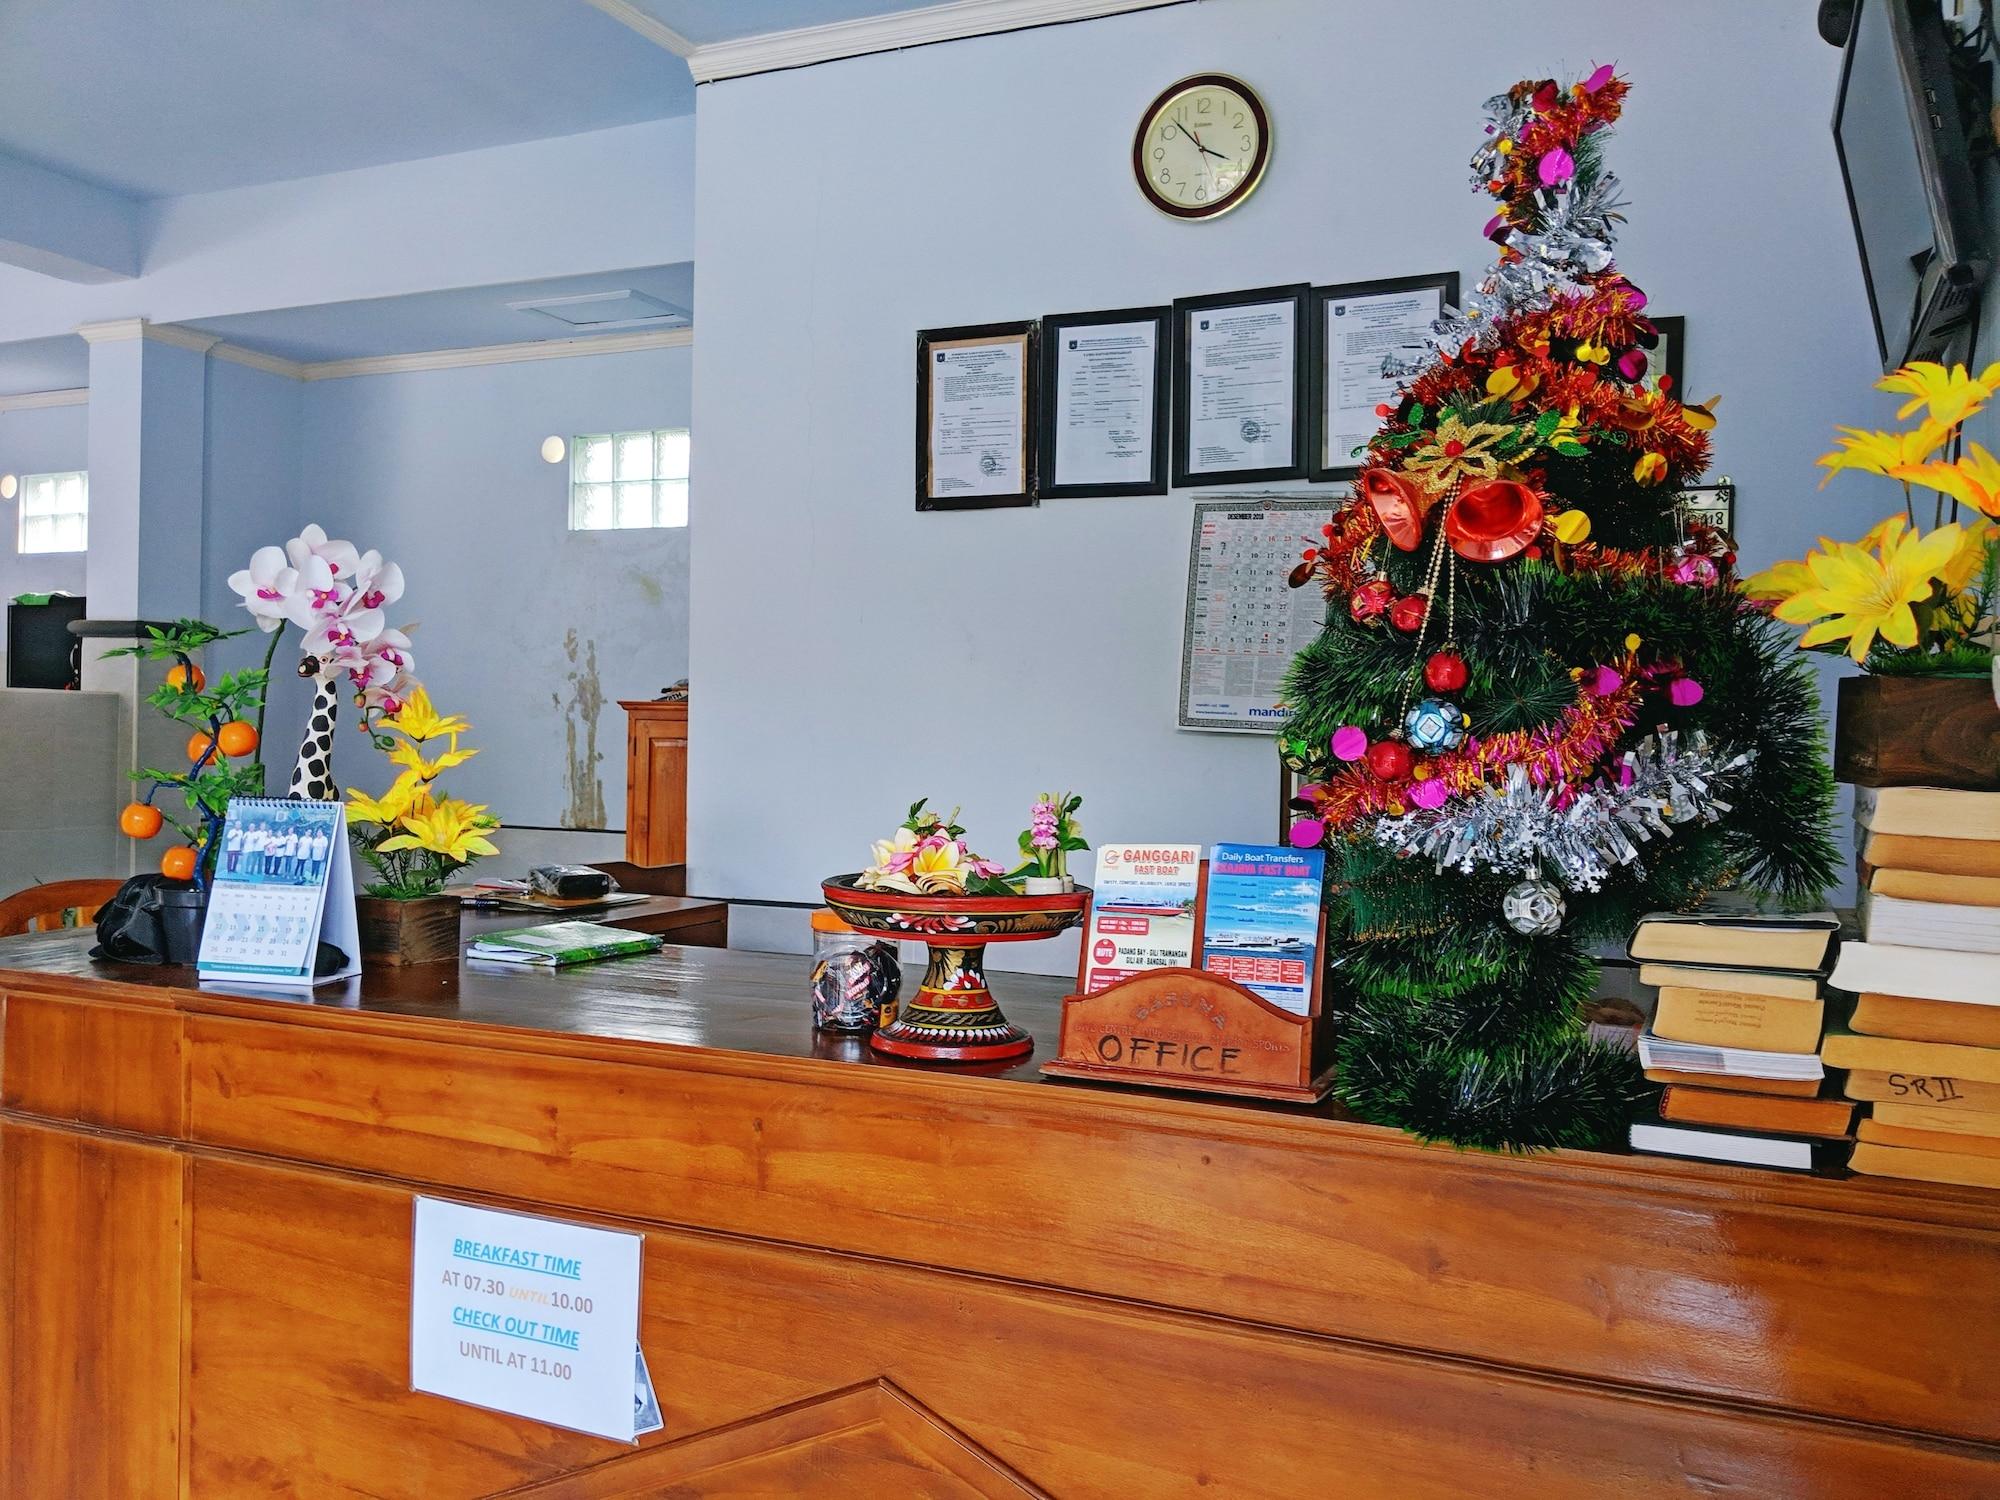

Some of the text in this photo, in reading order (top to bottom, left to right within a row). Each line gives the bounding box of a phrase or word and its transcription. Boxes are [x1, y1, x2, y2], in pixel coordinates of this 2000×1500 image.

[1177, 106, 1188, 122] 11
[1197, 97, 1211, 114] 12
[1223, 100, 1226, 116] 1
[1232, 112, 1244, 129] 2
[1160, 125, 1177, 142] 10
[1240, 135, 1251, 152] 3
[1153, 147, 1165, 163] 9
[1233, 158, 1243, 175] 4
[1159, 168, 1171, 184] 8
[1216, 177, 1229, 192] 5
[1176, 182, 1186, 197] 7
[1195, 184, 1207, 201] 6
[1123, 849, 1195, 864] GANGGARI
[1222, 852, 1304, 863] Daily Boat Transfers
[1134, 865, 1179, 875] FAST BOAT
[1137, 948, 1146, 956] BAY
[1098, 1034, 1241, 1075] OFFICE
[453, 1237, 583, 1277] BREAKFAST TIME
[441, 1269, 593, 1314] AT 07.30 UNTIL 10.00
[453, 1306, 580, 1348] CHECK OUT TIME
[459, 1340, 572, 1381] UNTIL AT 11.00
